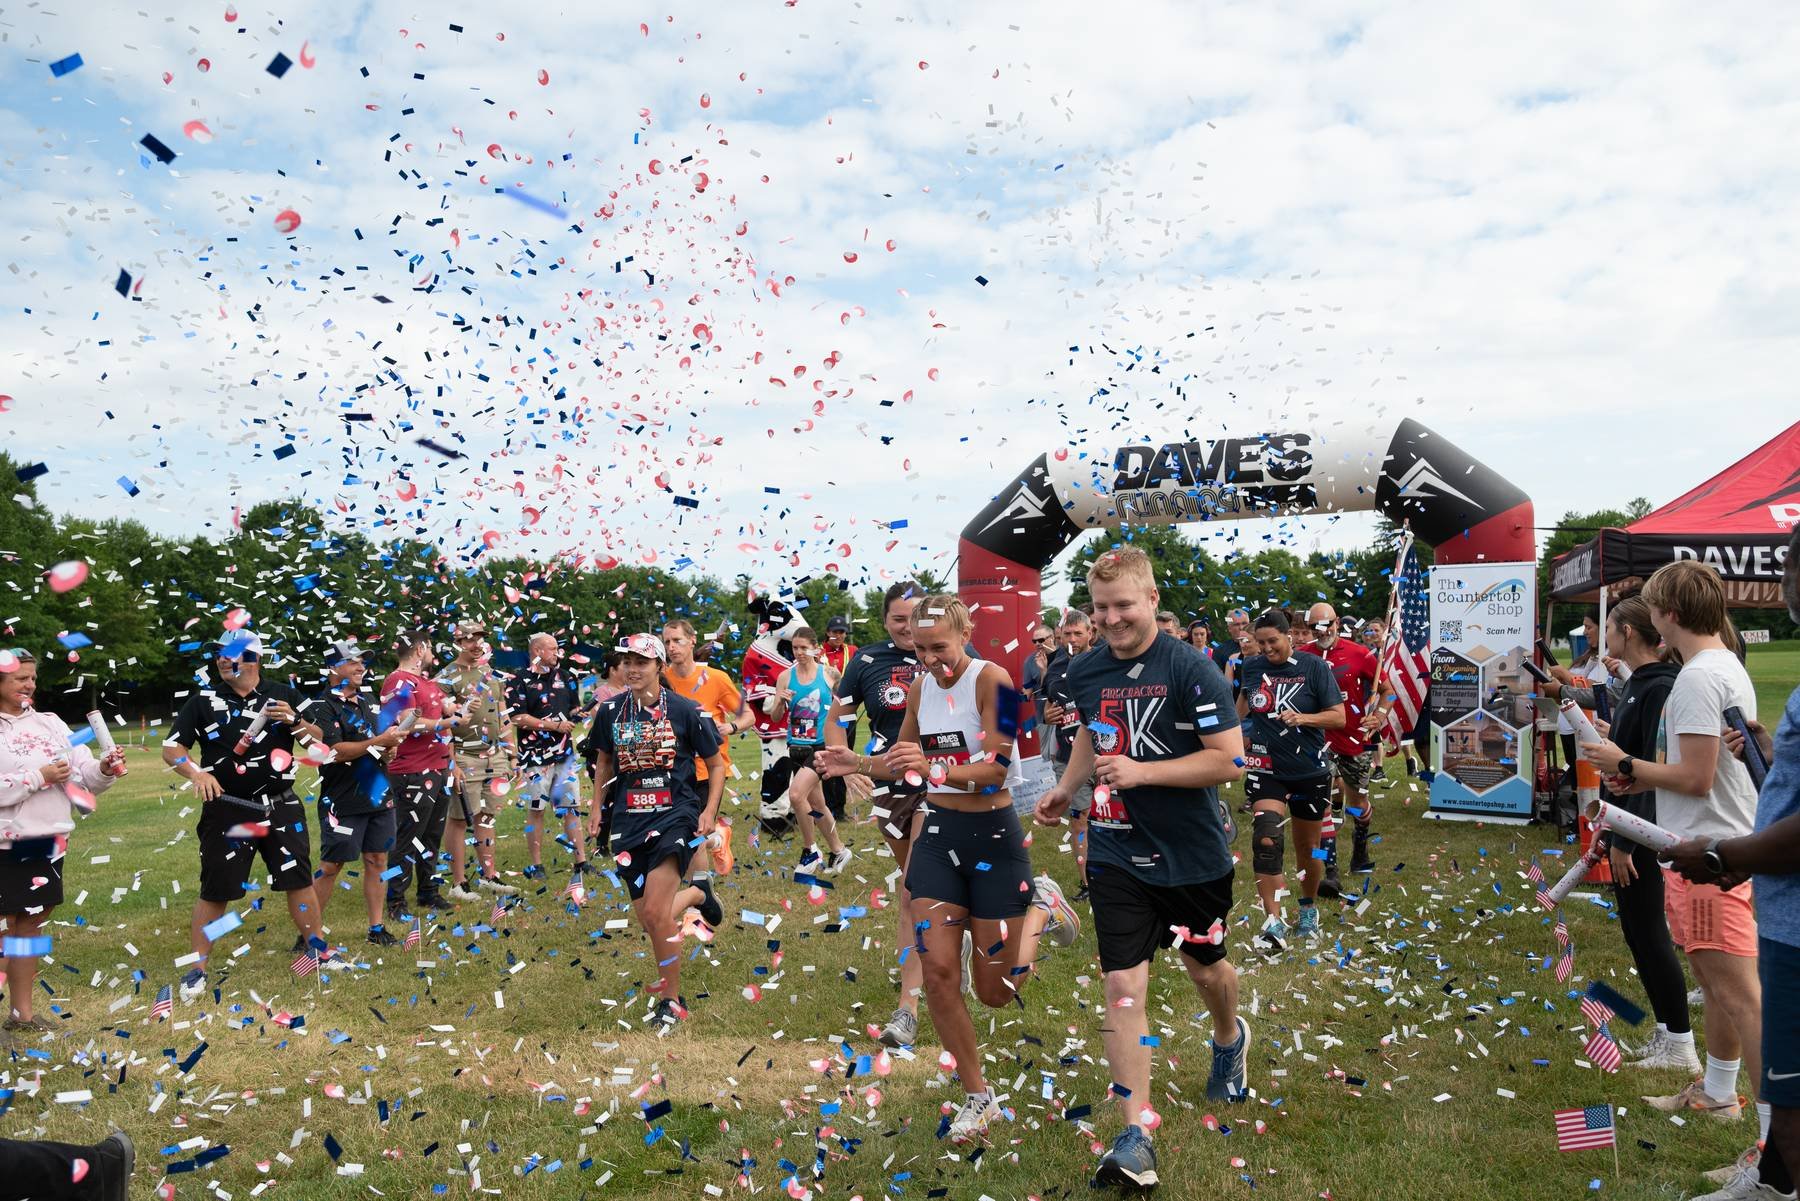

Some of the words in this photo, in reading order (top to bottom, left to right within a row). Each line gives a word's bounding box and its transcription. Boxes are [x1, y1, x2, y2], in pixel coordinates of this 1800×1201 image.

[1114, 433, 1313, 490] DAVES
[1116, 487, 1241, 519] running
[1437, 591, 1521, 604] Countertop
[1487, 603, 1523, 617] Shop
[1486, 627, 1505, 635] Scan
[1507, 627, 1521, 635] Me!
[1431, 653, 1456, 664] From
[1442, 664, 1477, 675] Dreaming
[1101, 684, 1168, 699] FIRECRACKER
[1099, 697, 1173, 757] 5K
[632, 793, 657, 806] 388
[1442, 799, 1517, 809] www.countertopshop.net
[1095, 803, 1112, 818] 411
